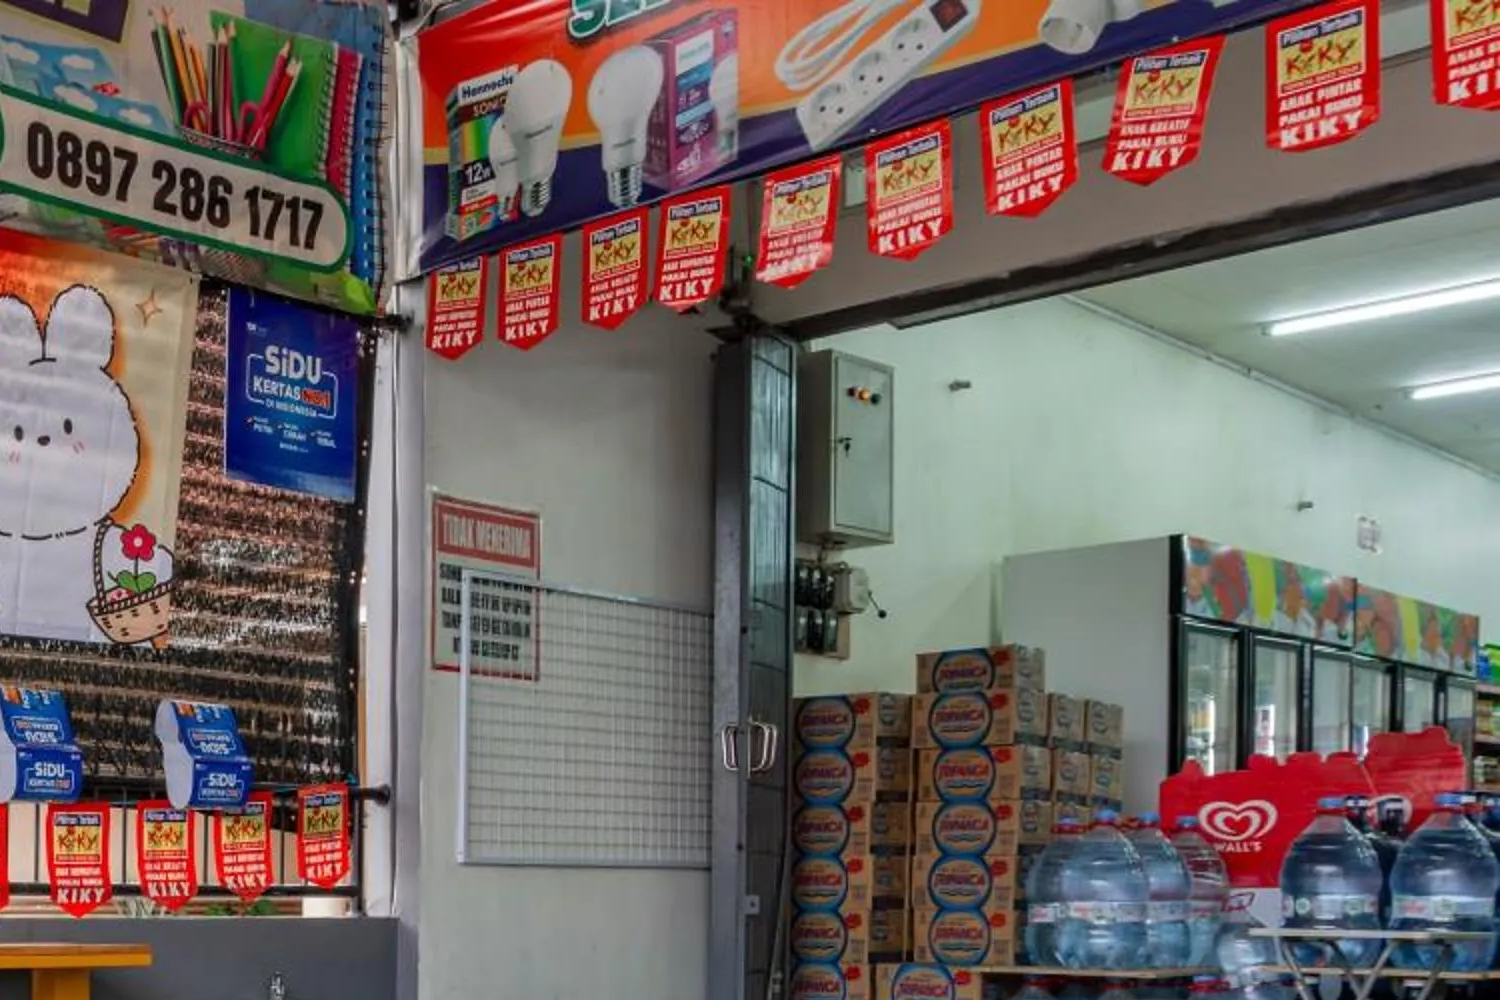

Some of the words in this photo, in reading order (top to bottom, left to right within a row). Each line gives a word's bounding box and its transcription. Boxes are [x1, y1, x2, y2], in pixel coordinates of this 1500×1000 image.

[1448, 69, 1500, 102] KI
[1280, 109, 1364, 147] KIKY
[26, 121, 138, 202] 0897
[152, 159, 233, 228] 286
[245, 184, 325, 251] 1717
[253, 377, 300, 400] KERTAS
